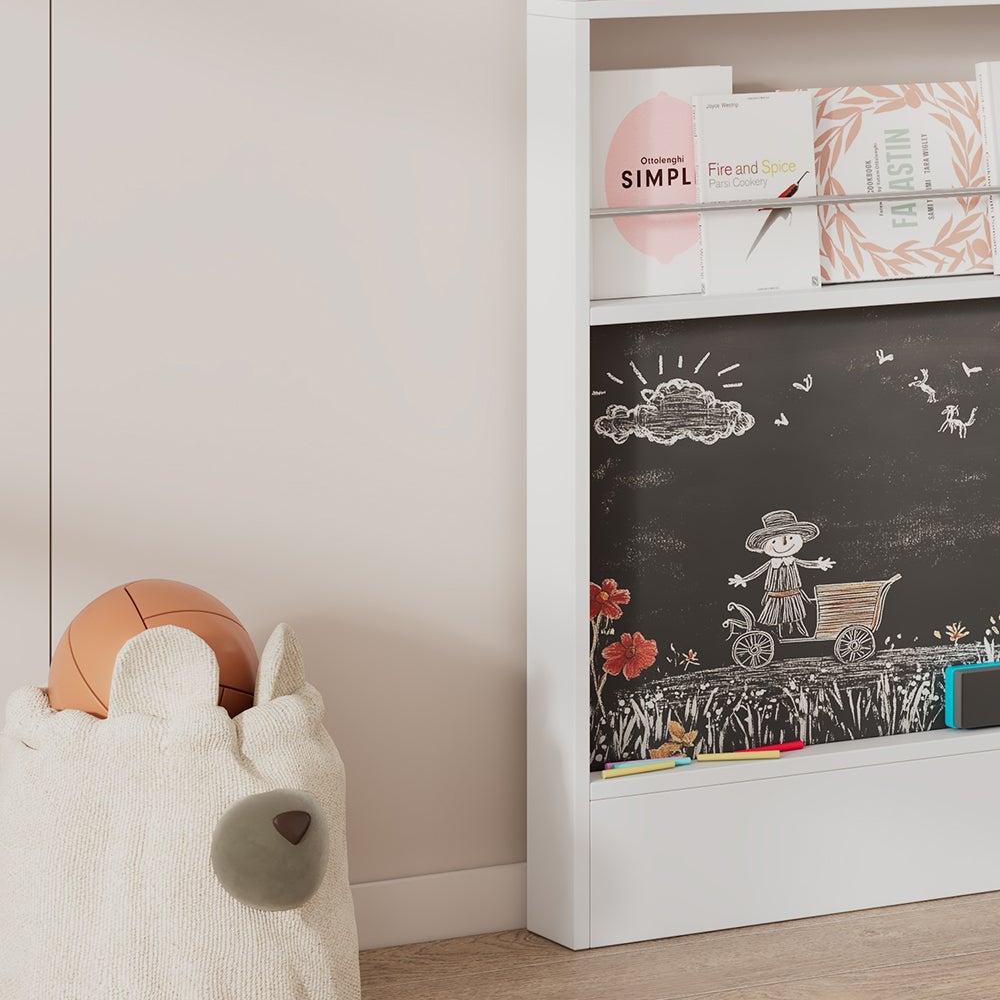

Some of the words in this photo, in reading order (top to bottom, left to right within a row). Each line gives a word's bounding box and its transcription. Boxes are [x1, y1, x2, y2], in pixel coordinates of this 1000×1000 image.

[640, 154, 685, 166] Ottolenghi
[708, 161, 733, 176] Fire
[735, 160, 758, 175] and
[761, 159, 797, 177] Spice
[621, 167, 692, 189] SIMPL
[708, 178, 731, 189] Parsi
[732, 177, 769, 189] Cookery
[883, 128, 918, 229] FAASTIN
